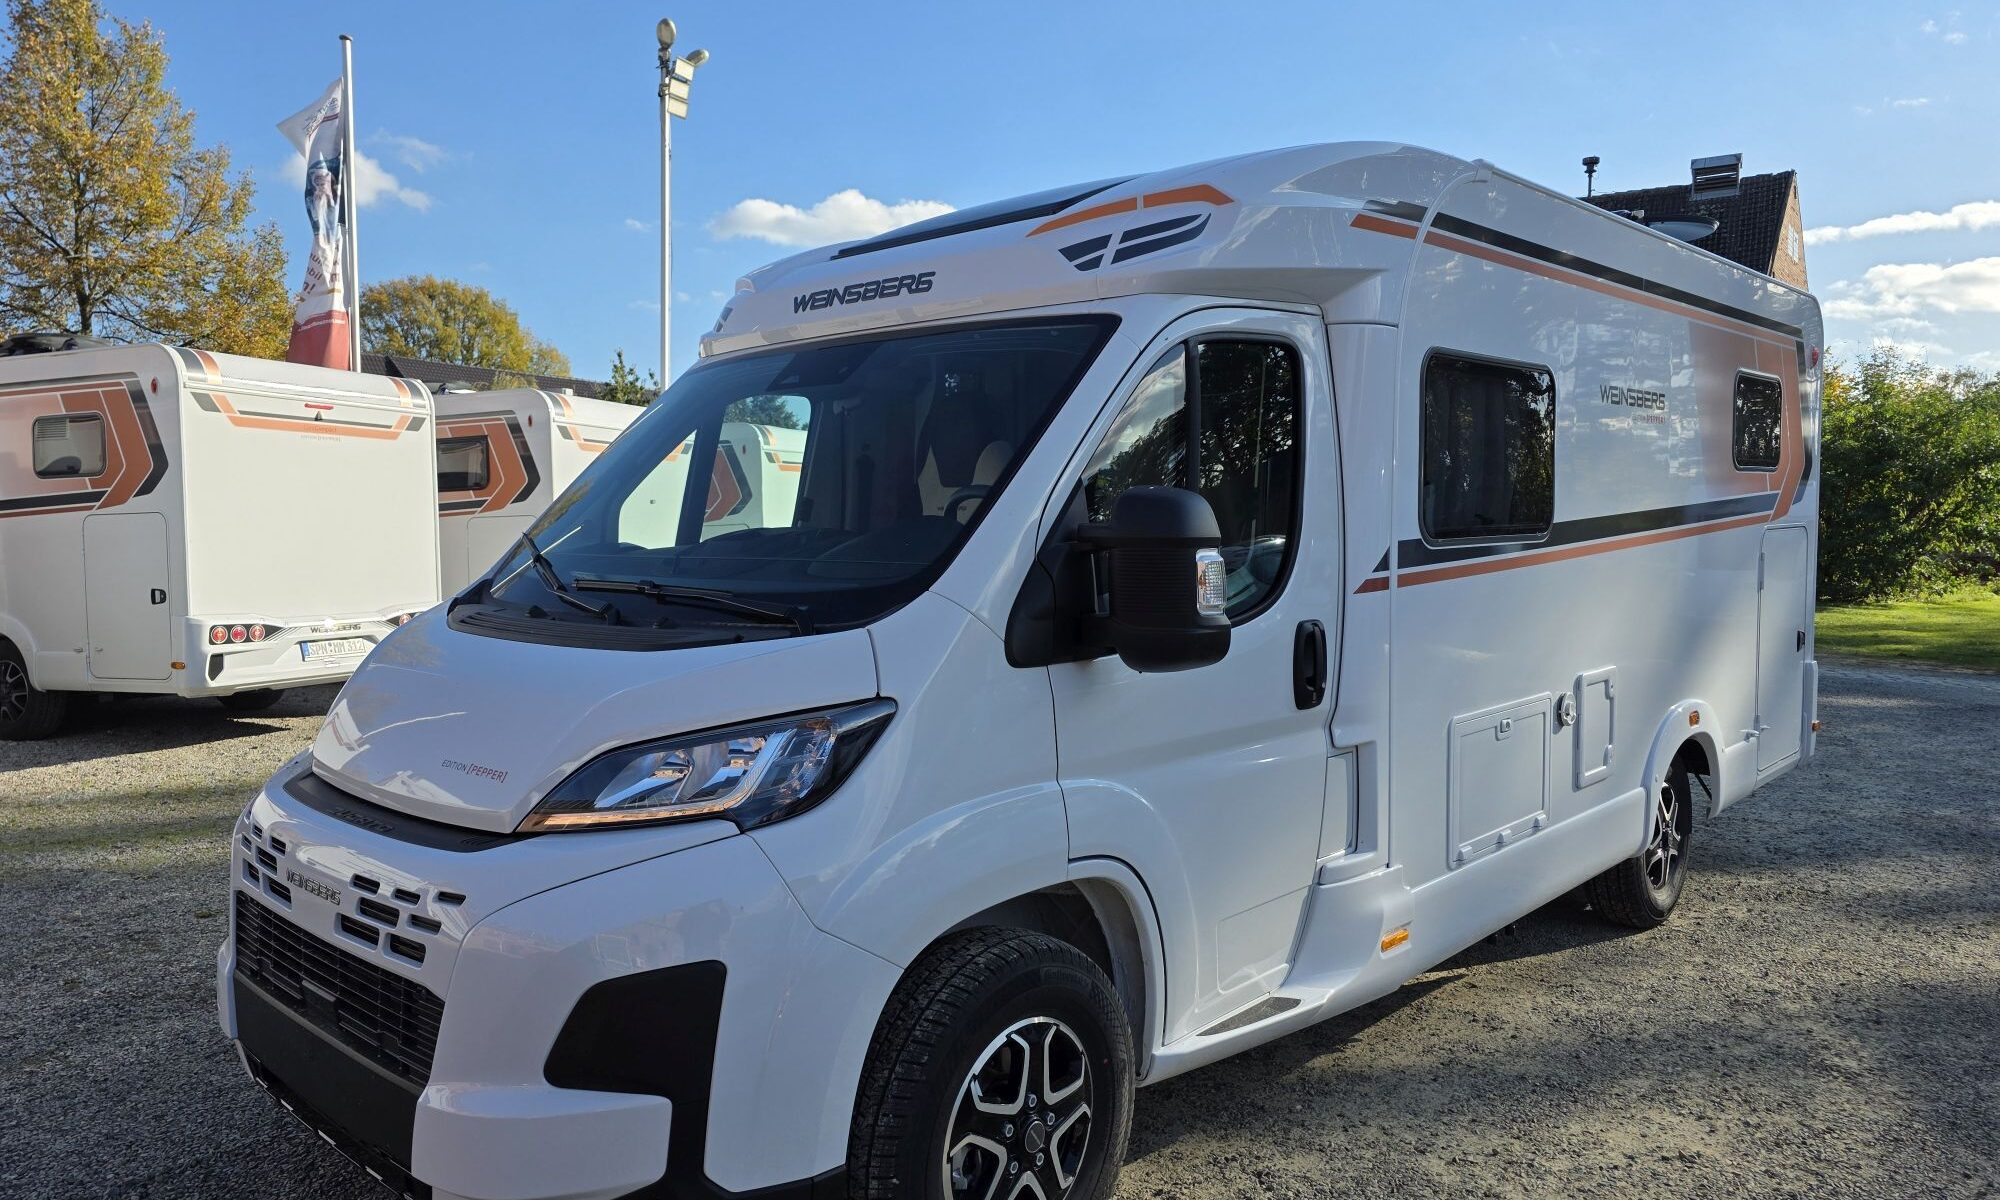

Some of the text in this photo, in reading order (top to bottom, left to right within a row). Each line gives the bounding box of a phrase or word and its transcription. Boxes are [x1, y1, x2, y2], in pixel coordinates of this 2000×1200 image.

[793, 271, 936, 314] WEINSBERG
[1599, 384, 1666, 411] WEINSBERG
[309, 643, 328, 656] SPN
[347, 640, 364, 653] 312
[441, 759, 509, 783] EDITION [PEPPER]
[286, 868, 341, 906] WEINSBERG
